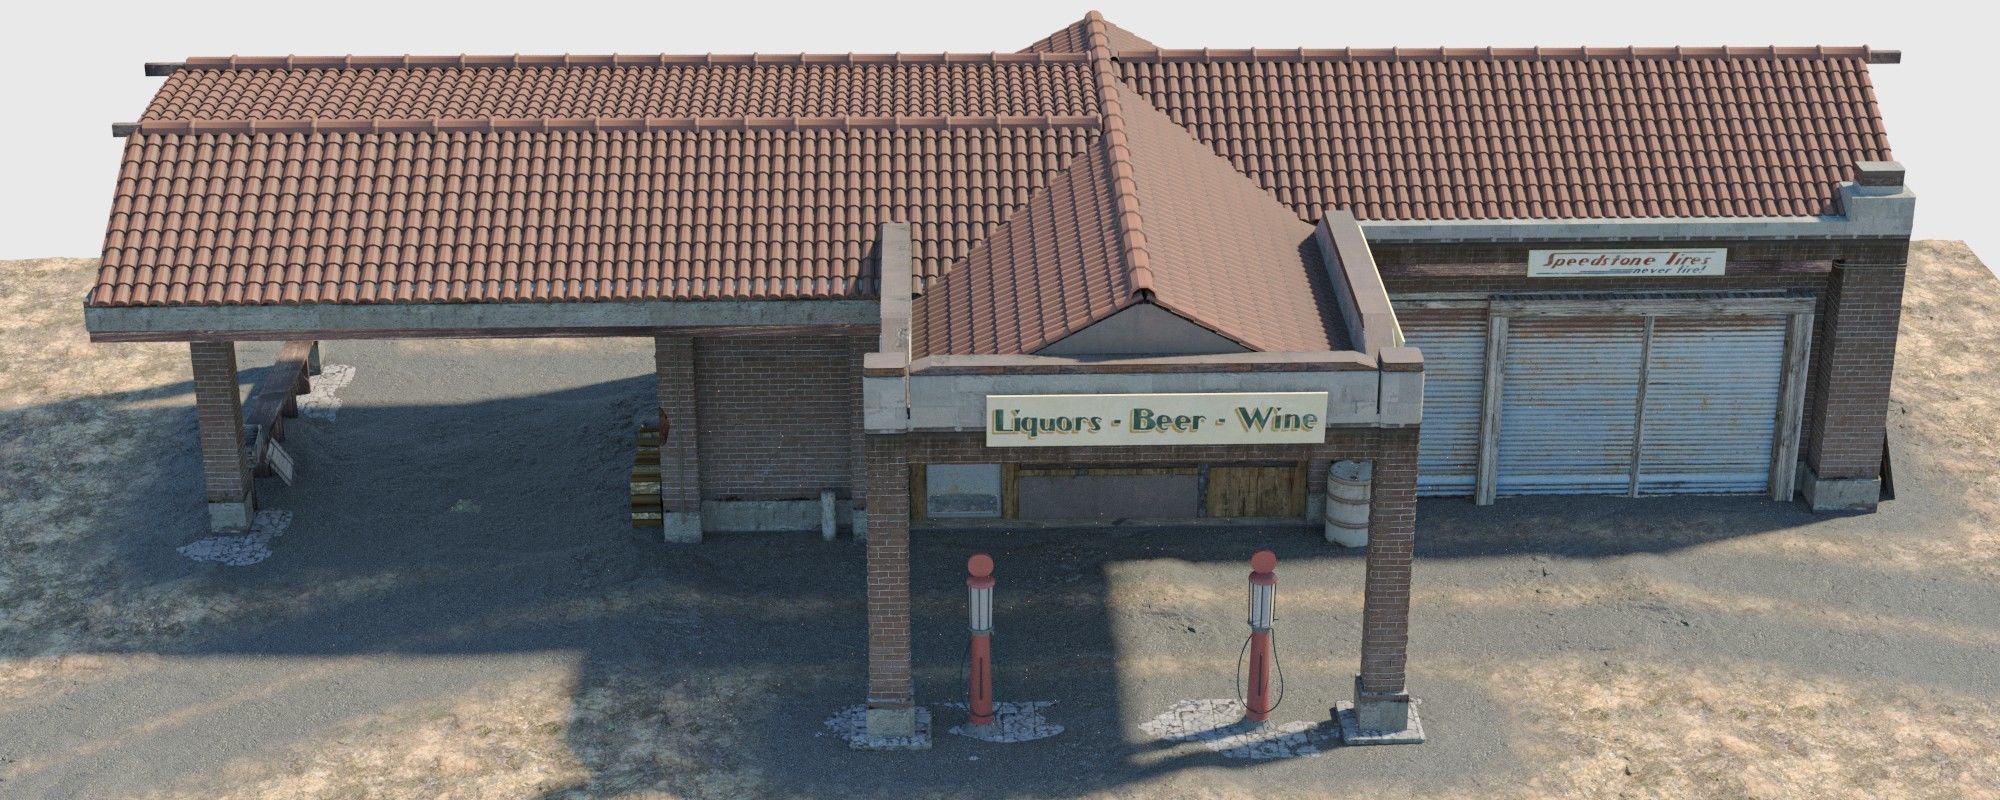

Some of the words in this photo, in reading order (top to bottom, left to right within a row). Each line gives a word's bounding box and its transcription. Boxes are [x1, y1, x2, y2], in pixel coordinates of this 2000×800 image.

[1543, 253, 1657, 269] Speedstone
[1665, 252, 1712, 266] Tires
[1632, 267, 1672, 275] never
[992, 409, 1102, 440] Liquors
[1130, 408, 1206, 434] Beer
[1235, 406, 1318, 433] Wine
